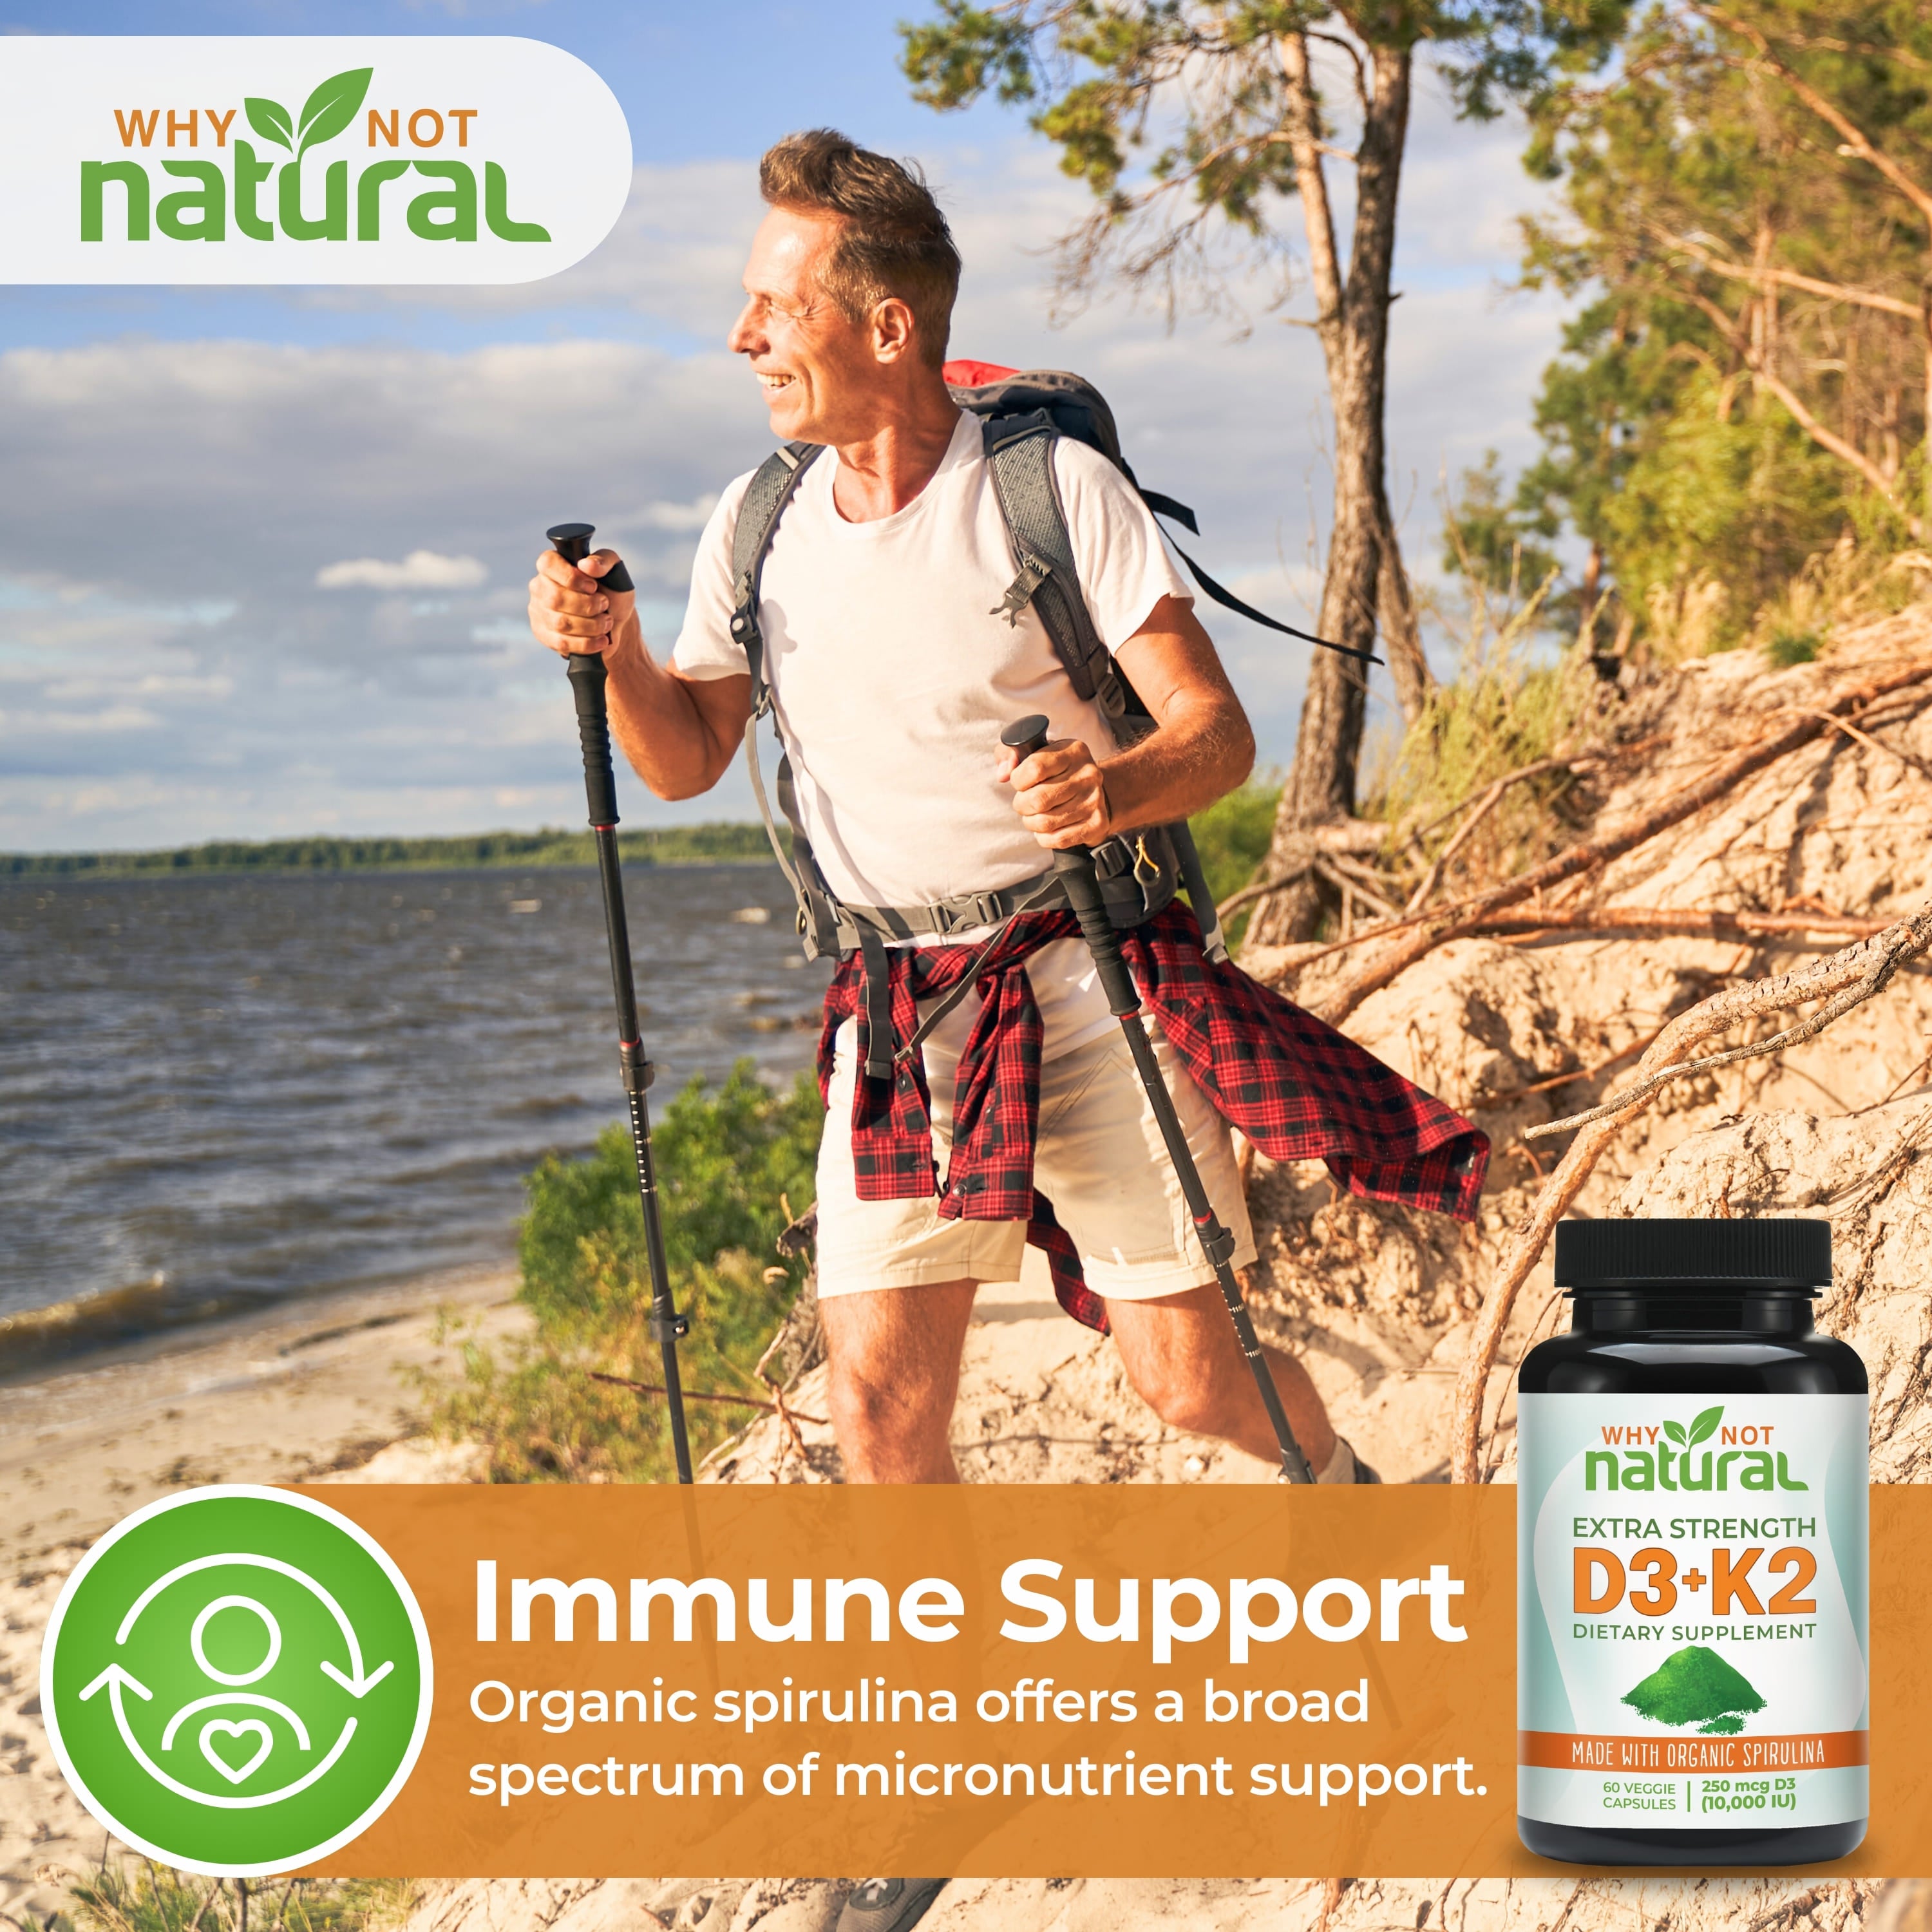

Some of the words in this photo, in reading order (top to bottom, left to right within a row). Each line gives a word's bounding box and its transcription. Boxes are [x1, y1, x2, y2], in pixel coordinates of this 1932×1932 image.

[1601, 1426, 1660, 1445] WHY
[1721, 1425, 1775, 1446] NOT
[1585, 1441, 1810, 1492] natural
[1573, 1517, 1662, 1539] EXTRA
[1670, 1517, 1816, 1539] STRENGTH
[1573, 1546, 1818, 1617] D3+K2
[1573, 1624, 1664, 1640] DIETARY
[1672, 1623, 1817, 1641] SUPPLEMENT
[1572, 1741, 1614, 1766] MADE
[1622, 1743, 1660, 1767] WITH
[1667, 1743, 1736, 1768] ORGANIC
[1743, 1739, 1825, 1767] SPIRULINA
[1603, 1781, 1620, 1793] 60
[1624, 1782, 1676, 1795] VEGGIE
[1701, 1779, 1731, 1793] 250
[1734, 1780, 1770, 1794] mcg
[1775, 1777, 1796, 1792] D3
[1603, 1797, 1676, 1810] CAPSULES
[1701, 1794, 1766, 1814] (10,000
[1772, 1793, 1797, 1810] IU)
